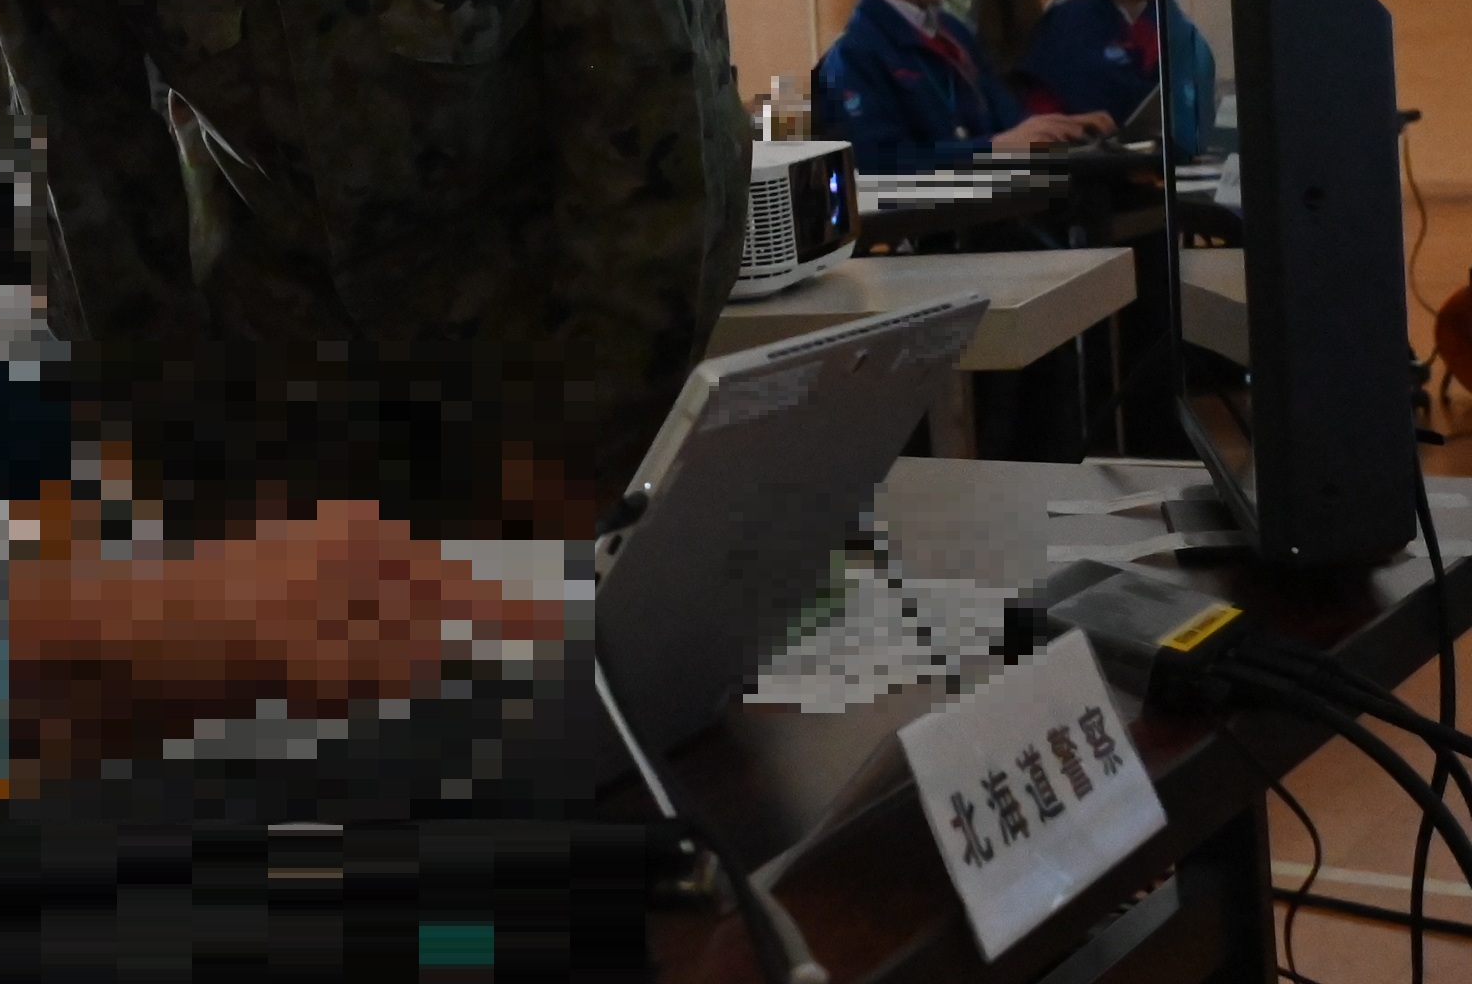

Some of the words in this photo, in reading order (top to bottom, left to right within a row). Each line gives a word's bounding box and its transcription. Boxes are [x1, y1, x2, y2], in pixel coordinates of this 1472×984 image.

[950, 706, 1124, 868] 北海道警察
